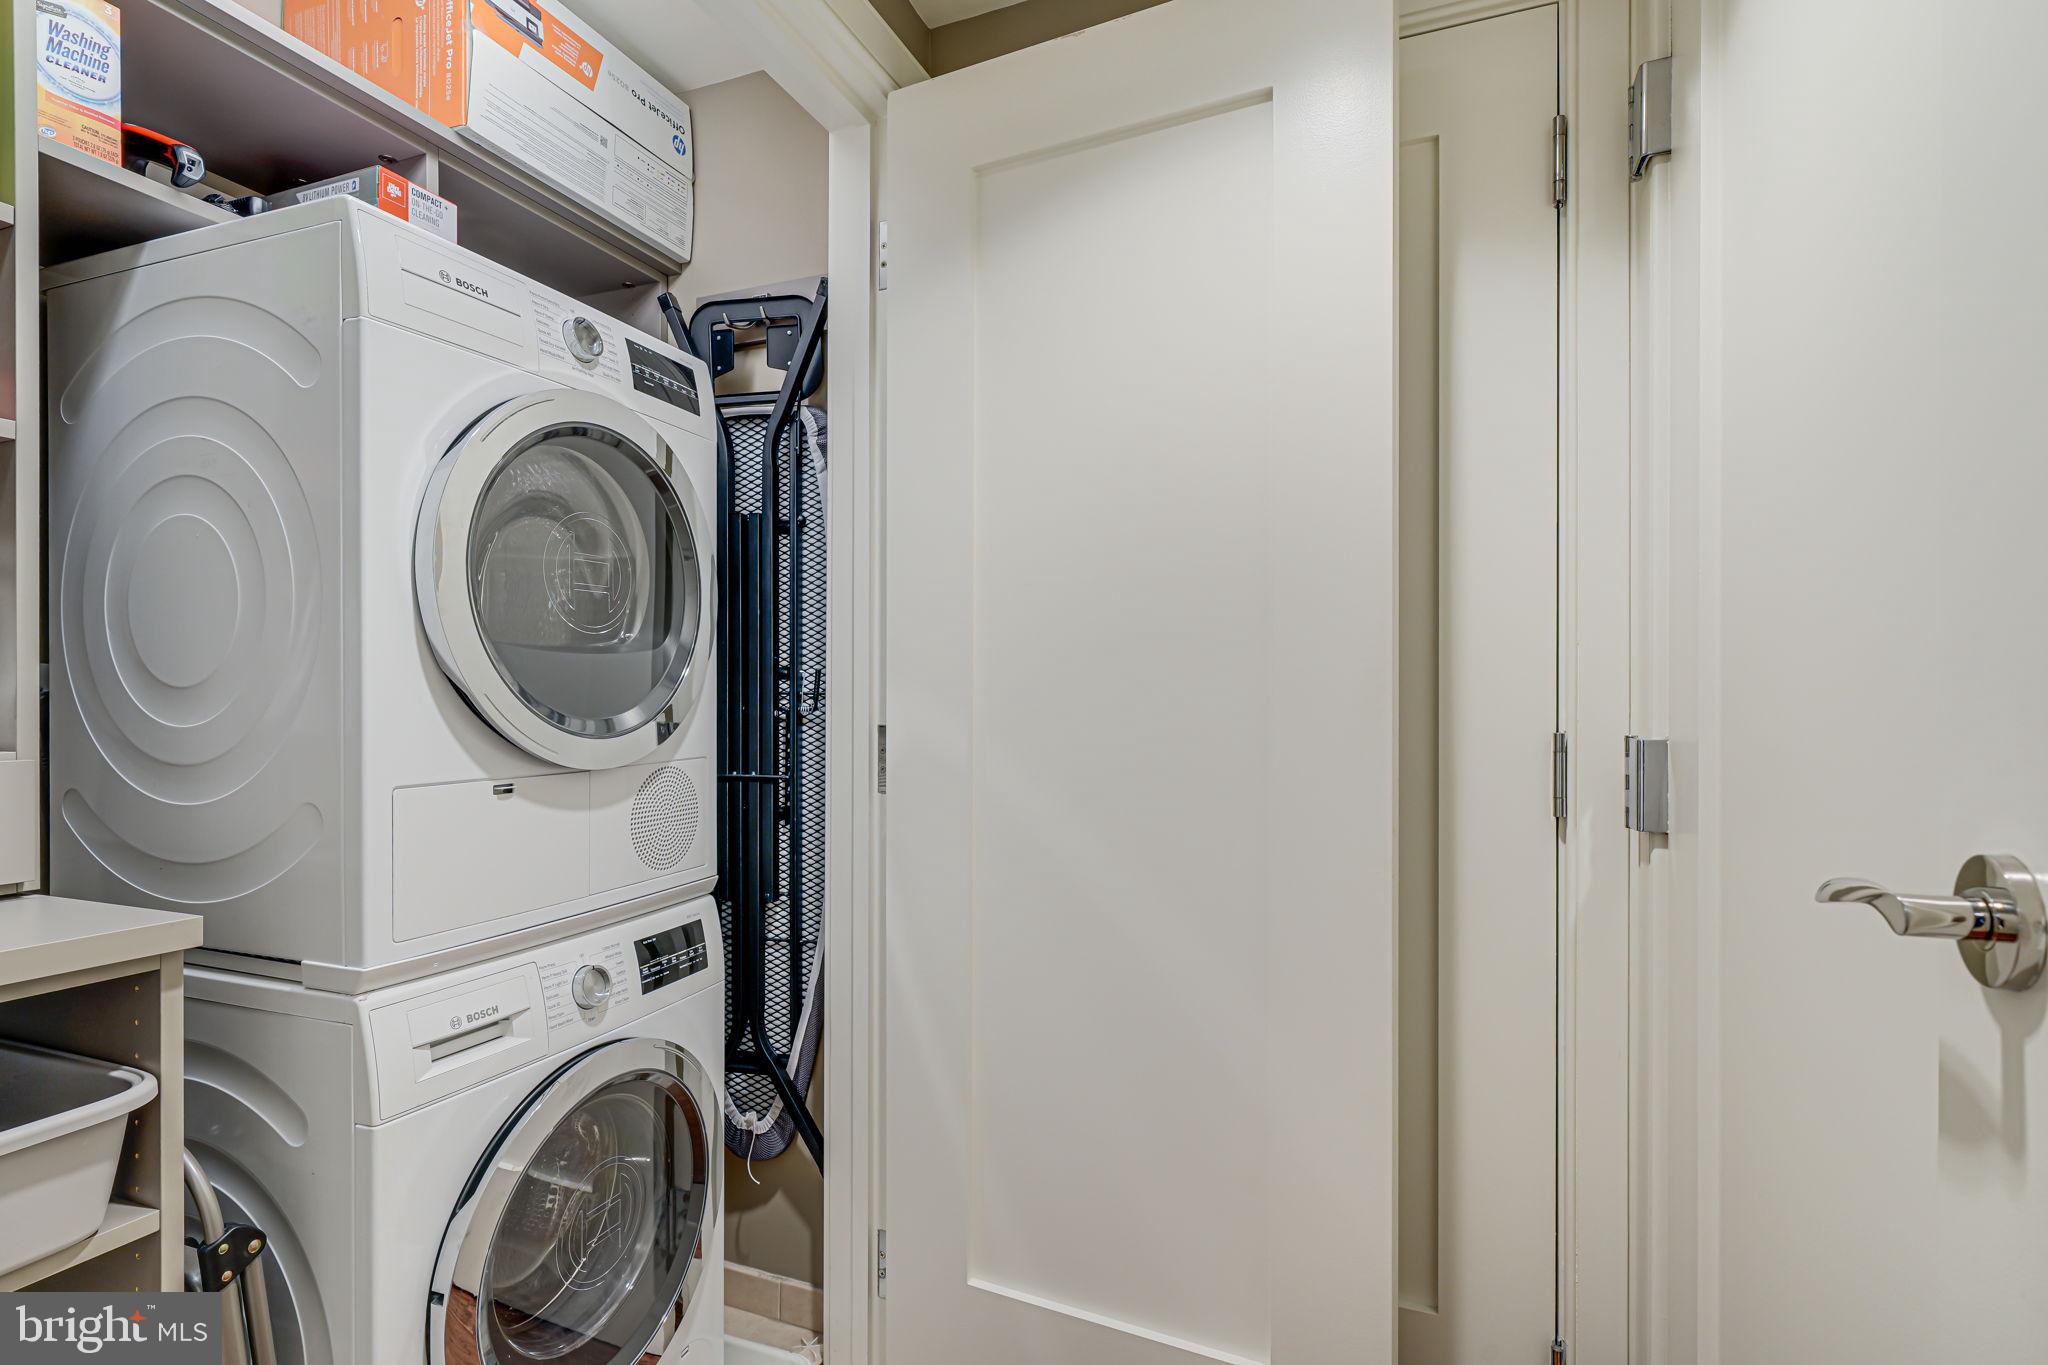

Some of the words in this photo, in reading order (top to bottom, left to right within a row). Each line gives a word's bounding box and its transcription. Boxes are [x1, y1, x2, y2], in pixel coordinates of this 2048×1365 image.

[48, 19, 111, 61] Washing
[45, 36, 110, 74] Machine
[446, 48, 454, 70] Pro
[45, 55, 106, 84] CLEANER
[631, 89, 647, 107] Pro
[648, 102, 686, 135] OfficeJet
[672, 135, 686, 156] hp
[309, 187, 330, 201] LITHIUM
[330, 182, 350, 196] POWER
[411, 187, 442, 209] COMPACT
[411, 197, 444, 220] ON-THE-GO
[411, 207, 440, 228] CLEANING
[455, 277, 489, 298] BOSCH
[466, 1004, 500, 1024] BOSCH
